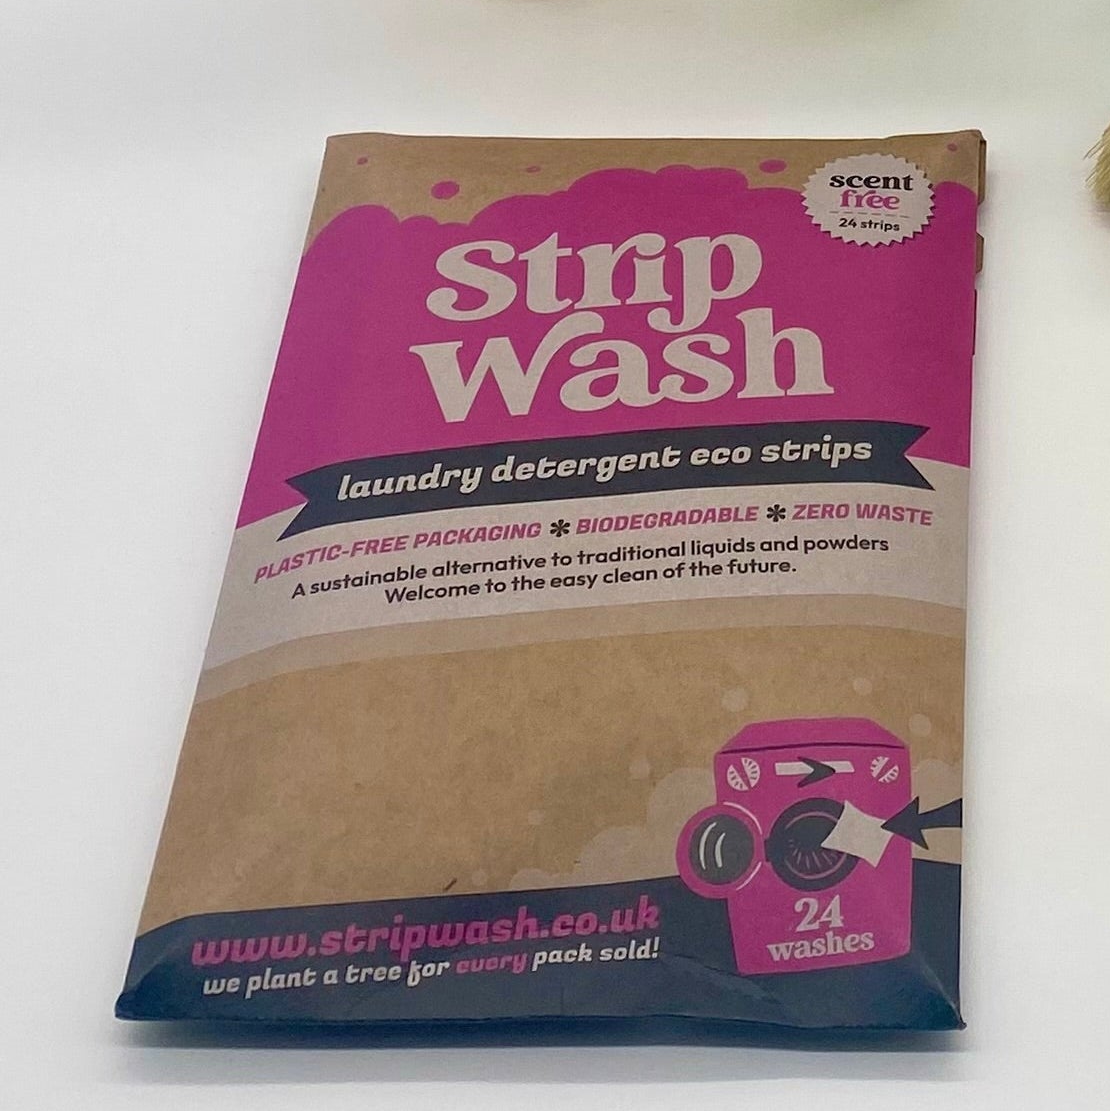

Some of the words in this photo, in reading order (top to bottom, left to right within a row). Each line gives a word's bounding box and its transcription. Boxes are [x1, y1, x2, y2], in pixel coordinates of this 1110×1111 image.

[829, 174, 914, 191] scent
[839, 189, 900, 210] free
[838, 217, 857, 229] 24
[860, 219, 900, 233] strips
[426, 232, 763, 333] Strip
[409, 307, 835, 423] Wash
[336, 462, 483, 502] laundry
[491, 446, 682, 483] detergent
[690, 444, 752, 466] eco
[760, 434, 873, 469] strips
[254, 534, 410, 584] PLASTIC-FREE
[413, 521, 542, 549] PACKAGING
[576, 506, 759, 535] BIODEGRADABLE
[791, 503, 850, 520] ZERO
[856, 503, 934, 526] WASTE
[291, 583, 306, 599] A
[309, 564, 427, 595] sustainable
[432, 554, 546, 579] alternative
[550, 551, 572, 567] to
[576, 541, 686, 565] traditional
[690, 537, 755, 559] liquids
[760, 535, 799, 552] and
[803, 534, 889, 555] powders
[384, 583, 480, 604] Welcome
[484, 578, 507, 593] to
[511, 574, 546, 592] the
[550, 573, 598, 590] easy
[603, 565, 658, 585] clean
[662, 561, 686, 579] of
[689, 560, 723, 577] the
[727, 558, 797, 575] future.
[191, 895, 660, 967] www.stripwash.co.uk
[794, 894, 844, 932] 24
[203, 975, 239, 995] we
[245, 968, 317, 999] plant
[323, 969, 339, 986] a
[345, 963, 401, 984] tree
[407, 959, 451, 987] for
[455, 952, 528, 976] every
[531, 942, 593, 971] pack
[598, 937, 660, 962] sold!
[767, 930, 875, 962] washes
